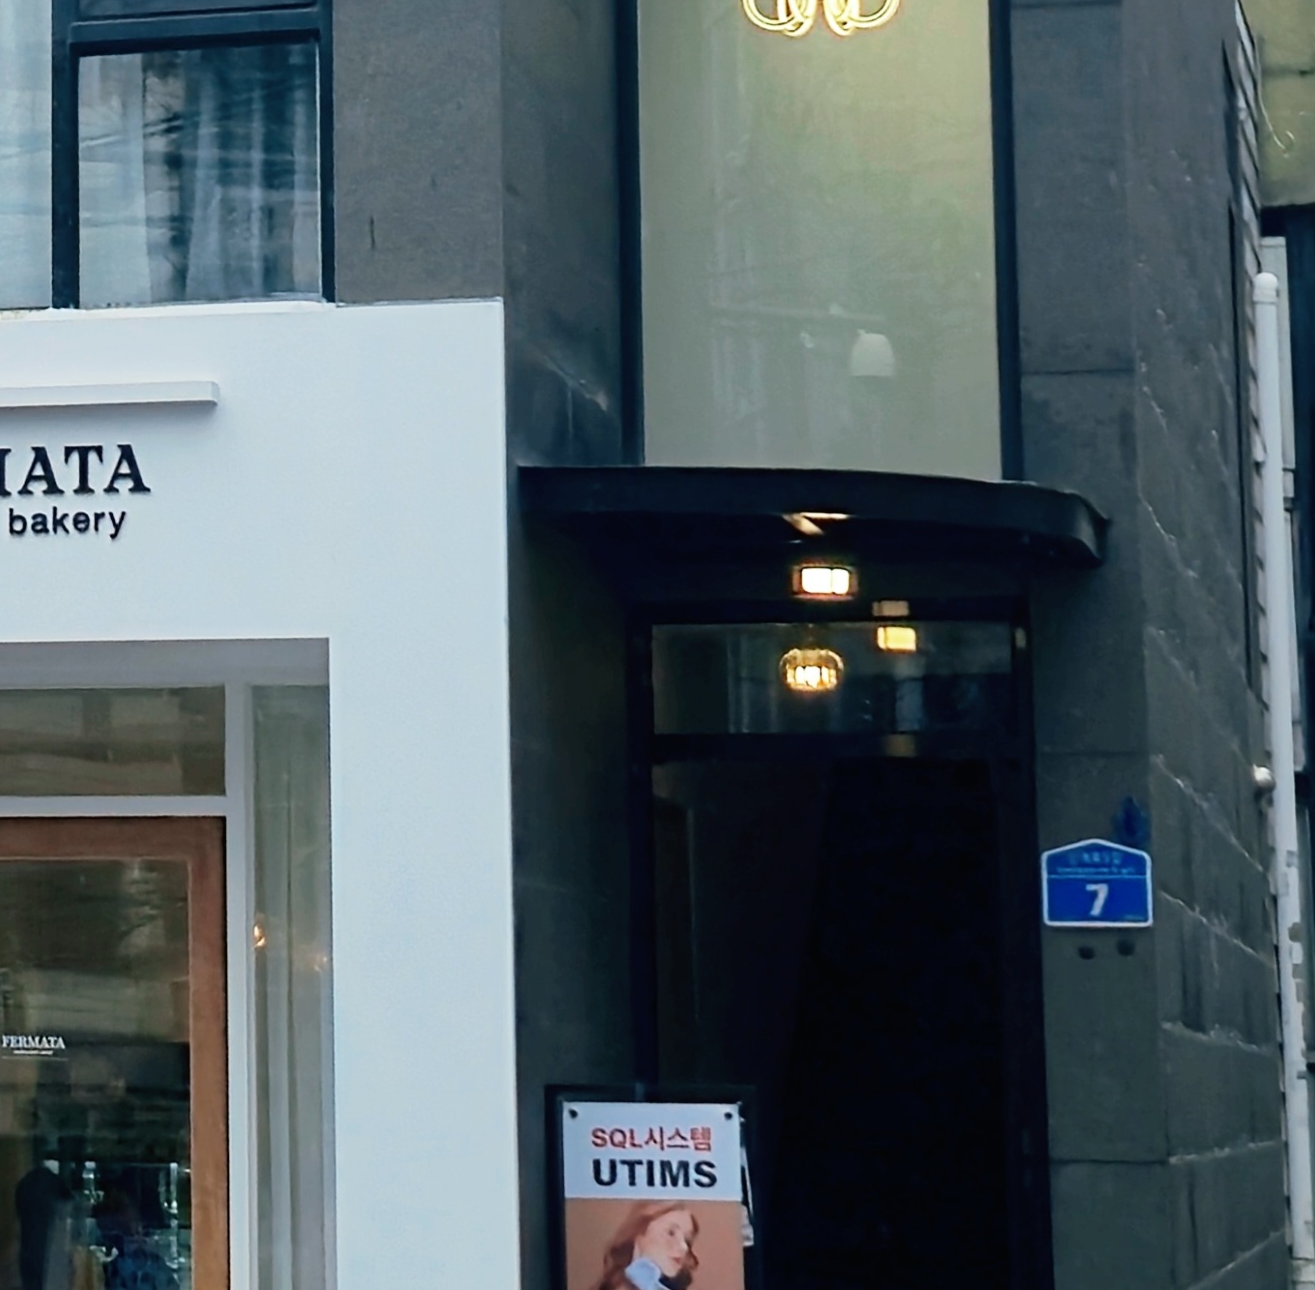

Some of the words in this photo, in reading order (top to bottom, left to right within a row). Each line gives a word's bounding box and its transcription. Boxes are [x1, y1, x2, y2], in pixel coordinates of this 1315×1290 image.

[8, 506, 127, 540] bakery
[1085, 882, 1109, 917] 7
[1, 1034, 66, 1050] FERMATA
[592, 1159, 718, 1189] UTIMS
